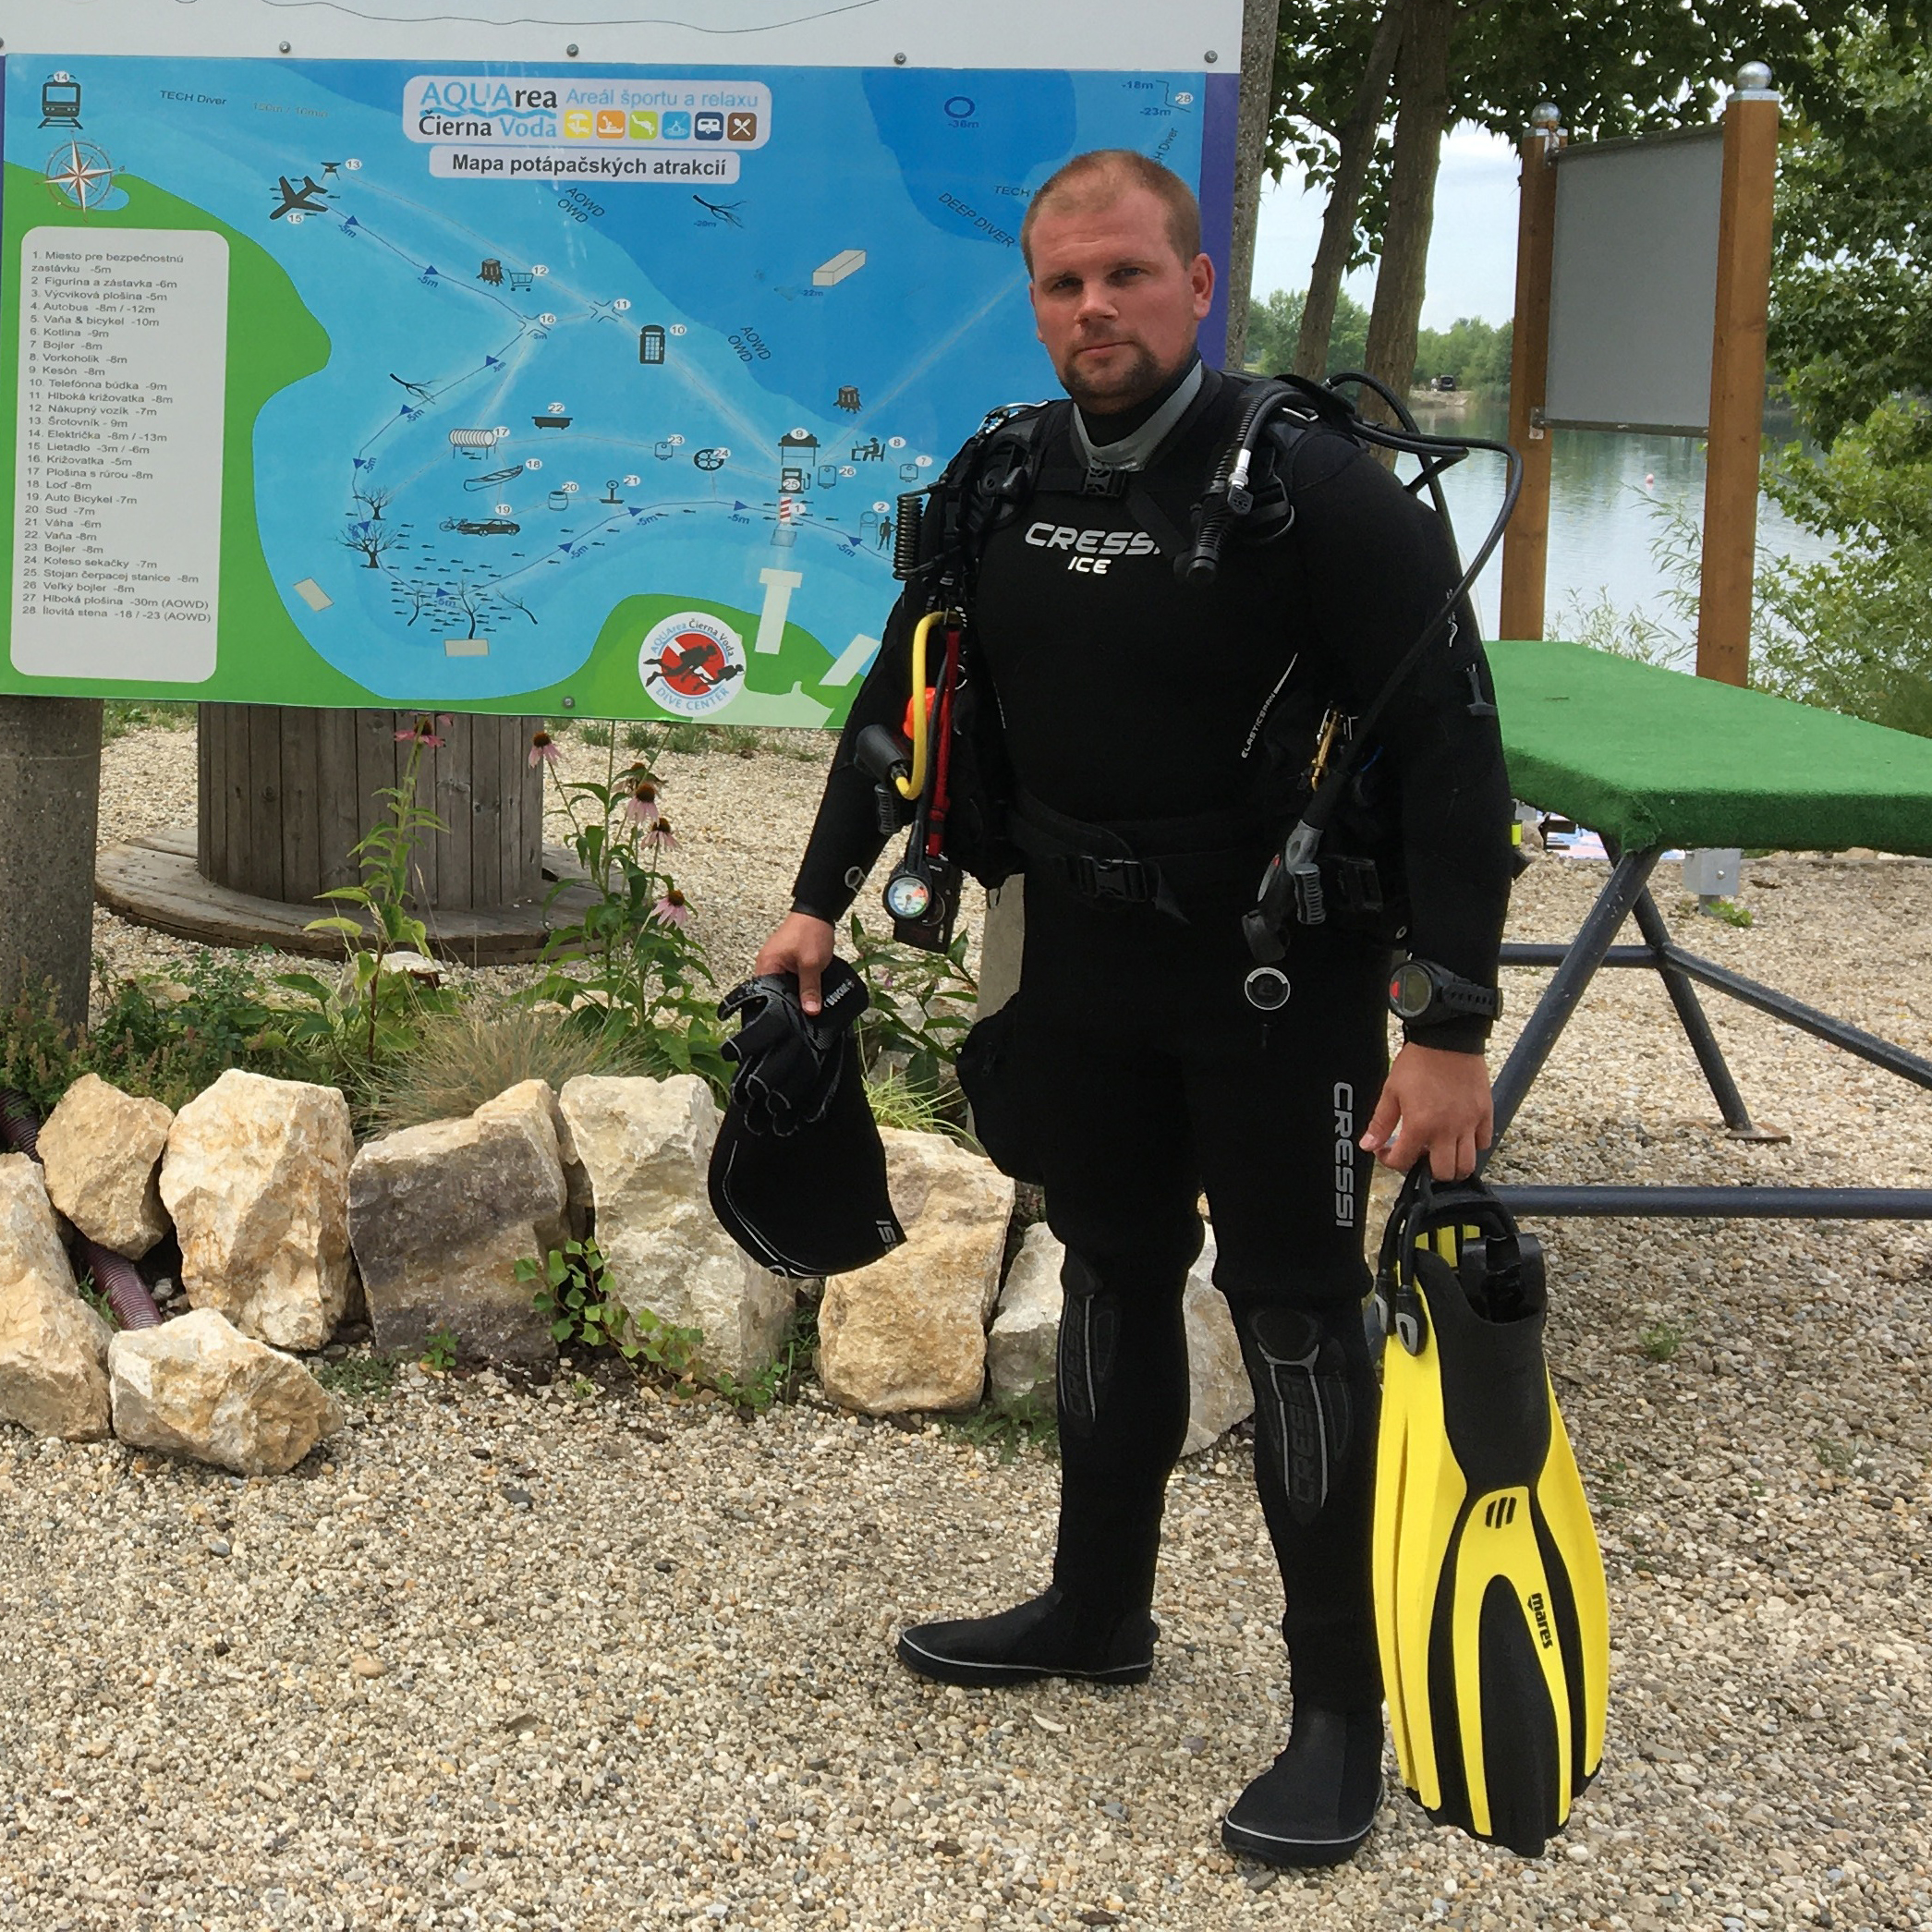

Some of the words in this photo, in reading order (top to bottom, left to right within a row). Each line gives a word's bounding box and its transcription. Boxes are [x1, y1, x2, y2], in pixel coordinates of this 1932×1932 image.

[1122, 81, 1154, 90] -18m
[161, 91, 193, 103] TECH
[198, 96, 227, 105] Diver
[419, 81, 558, 110] AQUArea
[565, 89, 614, 105] Areál
[620, 88, 678, 109] športu
[684, 94, 694, 107] a
[701, 92, 758, 108] relaxu
[1176, 94, 1191, 103] 28
[1140, 107, 1172, 116] -23m
[419, 110, 492, 137] Čierna
[499, 116, 556, 139] Voda
[1160, 128, 1179, 152] Diver
[346, 161, 359, 169] 13
[453, 153, 504, 176] Mapa
[510, 154, 647, 177] potápačských
[653, 158, 726, 176] atrakcií
[994, 185, 1031, 198] TECH
[565, 187, 605, 218] AOWD
[557, 199, 589, 224] OWD
[288, 214, 302, 223] 15
[939, 192, 975, 218] DEEP
[974, 216, 1015, 248] DIVER
[45, 251, 82, 261] Miesto
[85, 254, 103, 262] pre
[105, 253, 184, 262] bezpečnostnú
[31, 264, 80, 273] zastávku
[534, 266, 546, 274] 12
[103, 279, 152, 288] zástavka
[44, 289, 100, 300] Výcviková
[103, 292, 142, 301] plošina
[43, 302, 89, 311] Autobus
[616, 300, 628, 309] 11
[86, 316, 125, 327] bicykel
[541, 315, 554, 323] 16
[43, 327, 81, 337] Kotlina
[672, 326, 686, 334] 10
[43, 340, 76, 351] Bojler
[728, 335, 754, 362] OWD
[741, 326, 772, 361] AOWD
[43, 353, 100, 363] Vorkoholík
[48, 379, 102, 388] Telefónna
[105, 381, 140, 390] búdka
[47, 392, 86, 401] Hlboká
[89, 393, 145, 403] križovatka
[48, 404, 97, 416] Nákupný
[100, 407, 129, 415] vozík
[47, 416, 100, 427] Šrotovník
[47, 430, 101, 440] Električka
[495, 428, 508, 436] 17
[796, 430, 804, 438] 9
[47, 443, 91, 453] Lietadlo
[893, 438, 901, 447] 8
[714, 449, 729, 457] 24
[46, 455, 104, 466] Križovatka
[528, 460, 541, 468] 18
[46, 468, 87, 477] Plošina
[99, 469, 128, 479] rúrou
[840, 468, 854, 477] 26
[46, 480, 68, 490] Loď
[564, 483, 577, 492] 20
[784, 480, 798, 489] 25
[44, 492, 70, 503] Auto
[73, 493, 113, 504] Bicykel
[45, 505, 67, 514] Sud
[796, 504, 800, 513] 1
[878, 503, 885, 512] 2
[1025, 521, 1161, 555] CRESS
[44, 543, 76, 554] Bojler
[43, 556, 81, 565] Koleso
[1067, 556, 1112, 575] ICE
[43, 569, 79, 580] Stojan
[81, 570, 128, 582] čerpacej
[131, 573, 171, 582] stanice
[43, 581, 74, 593] Veľký
[76, 583, 107, 593] bojler
[43, 594, 81, 606] Hlboká
[84, 596, 124, 606] plošina
[161, 599, 209, 611] (AOWD)
[78, 609, 108, 617] stena
[164, 610, 211, 623] (AOWD)
[689, 617, 719, 636] Čierna
[719, 633, 735, 658] Voda
[656, 687, 682, 709] DIVE
[686, 687, 730, 711] CENTER
[1334, 1081, 1355, 1228] CRESSI
[1527, 1593, 1553, 1649] mares
